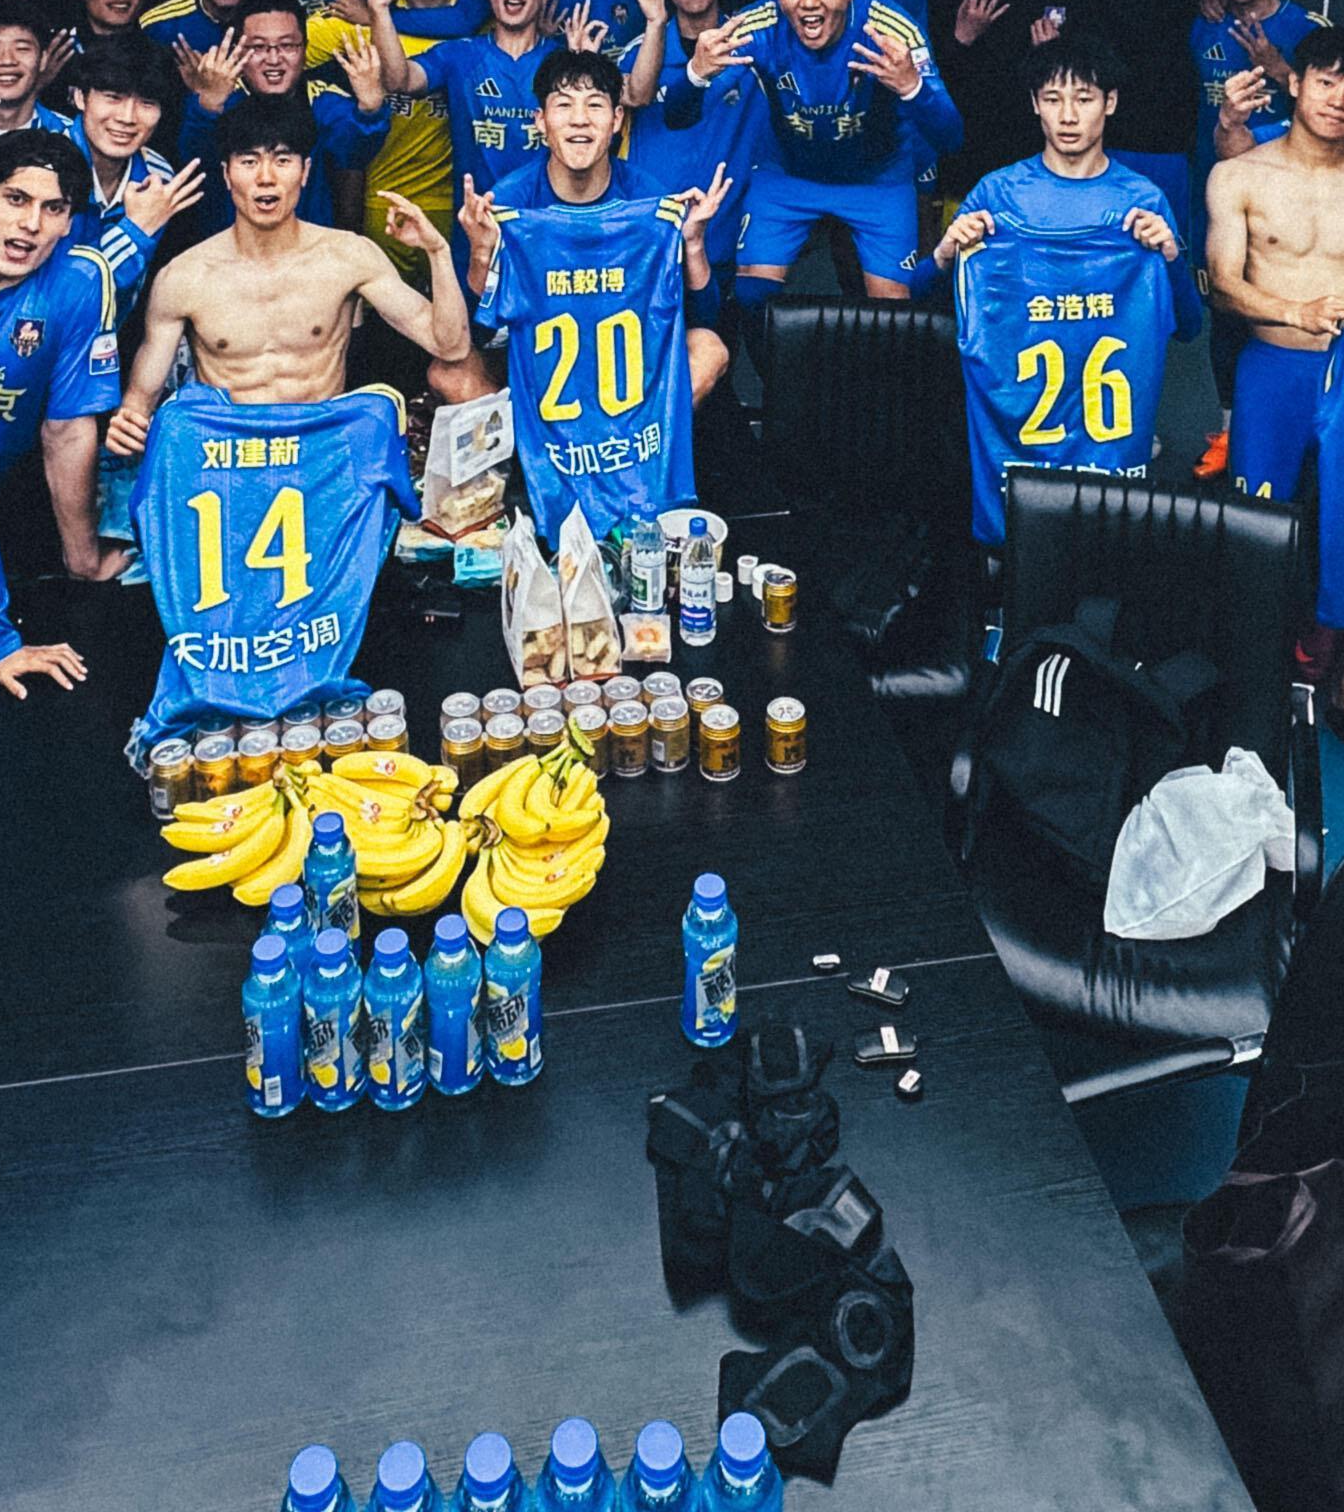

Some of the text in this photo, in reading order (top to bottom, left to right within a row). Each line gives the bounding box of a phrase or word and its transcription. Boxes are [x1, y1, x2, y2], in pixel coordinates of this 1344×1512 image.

[484, 105, 534, 119] NANJIN
[546, 267, 626, 297] 陈毅博
[1026, 292, 1116, 323] 金浩炜
[533, 309, 646, 423] 20
[1016, 336, 1133, 446] 26
[201, 434, 301, 470] 刘建新
[186, 486, 315, 613] 14
[169, 612, 342, 675] 天加空调
